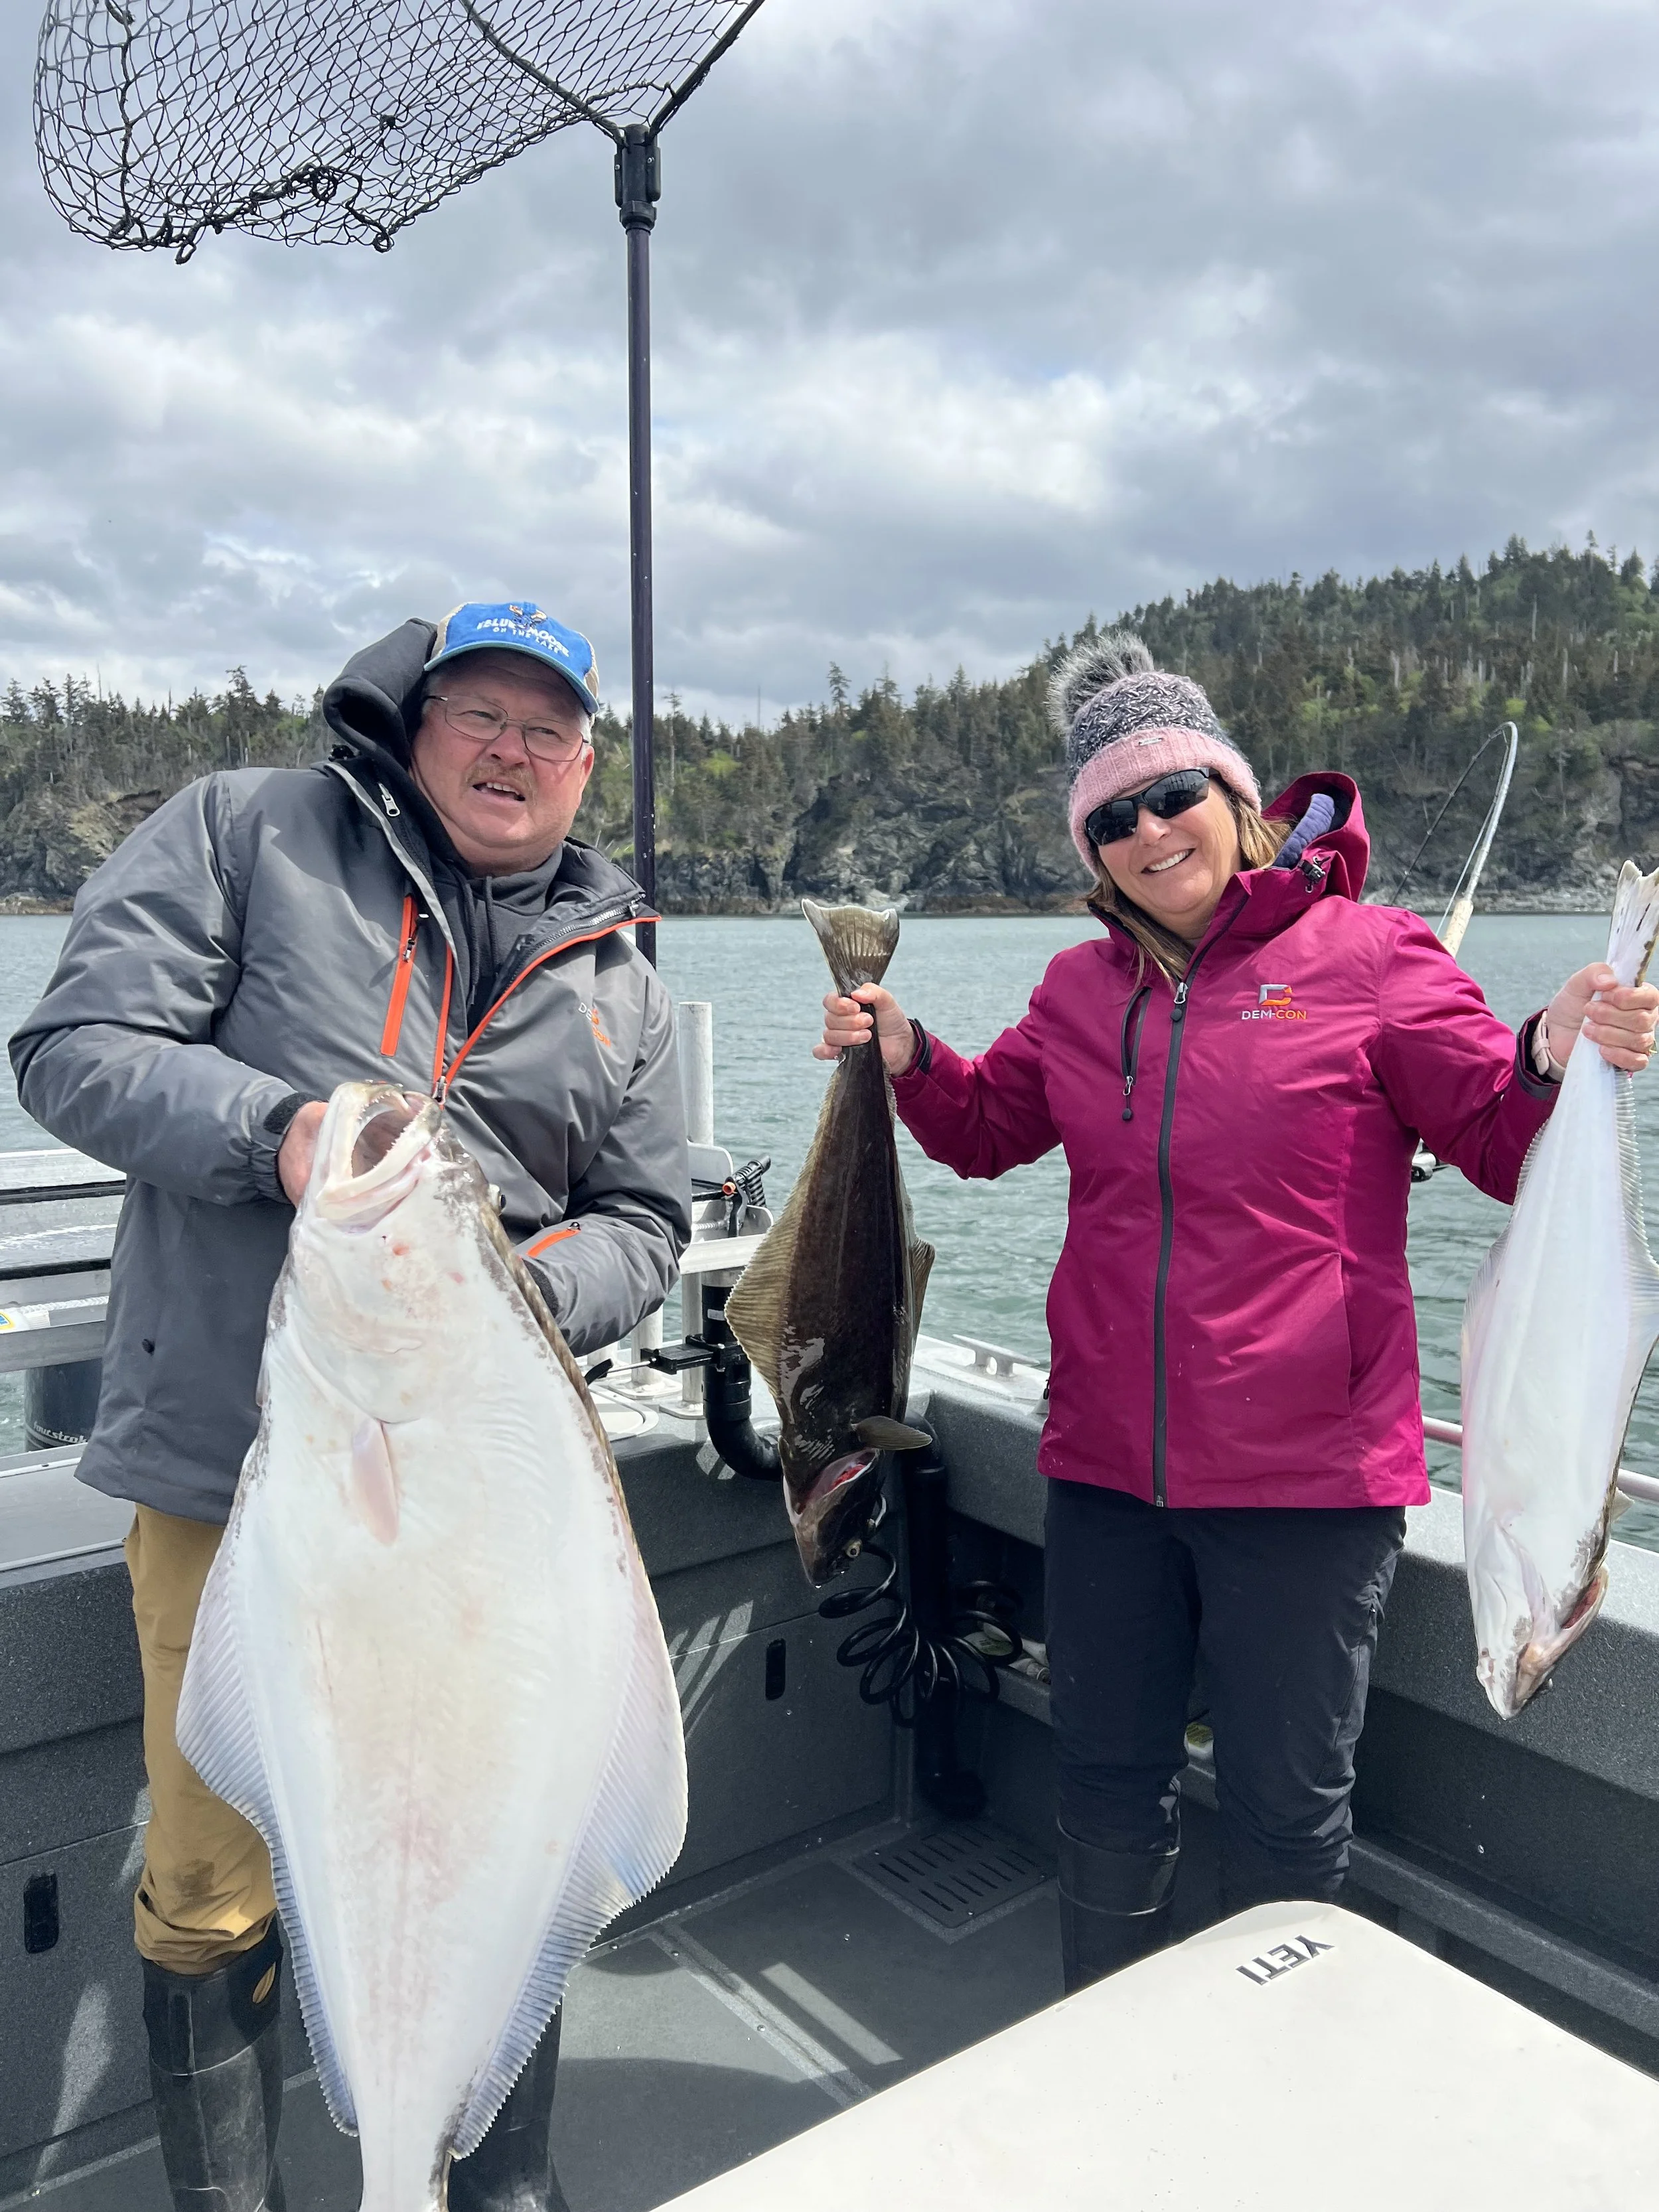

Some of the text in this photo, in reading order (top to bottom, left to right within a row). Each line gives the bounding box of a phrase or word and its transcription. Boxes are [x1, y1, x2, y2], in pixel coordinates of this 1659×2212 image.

[512, 628, 531, 638] THE
[536, 637, 559, 654] LAKE
[1242, 1009, 1307, 1019] DEM-CON
[33, 1421, 88, 1444] fourstrok
[1235, 1935, 1335, 1986] YETI
